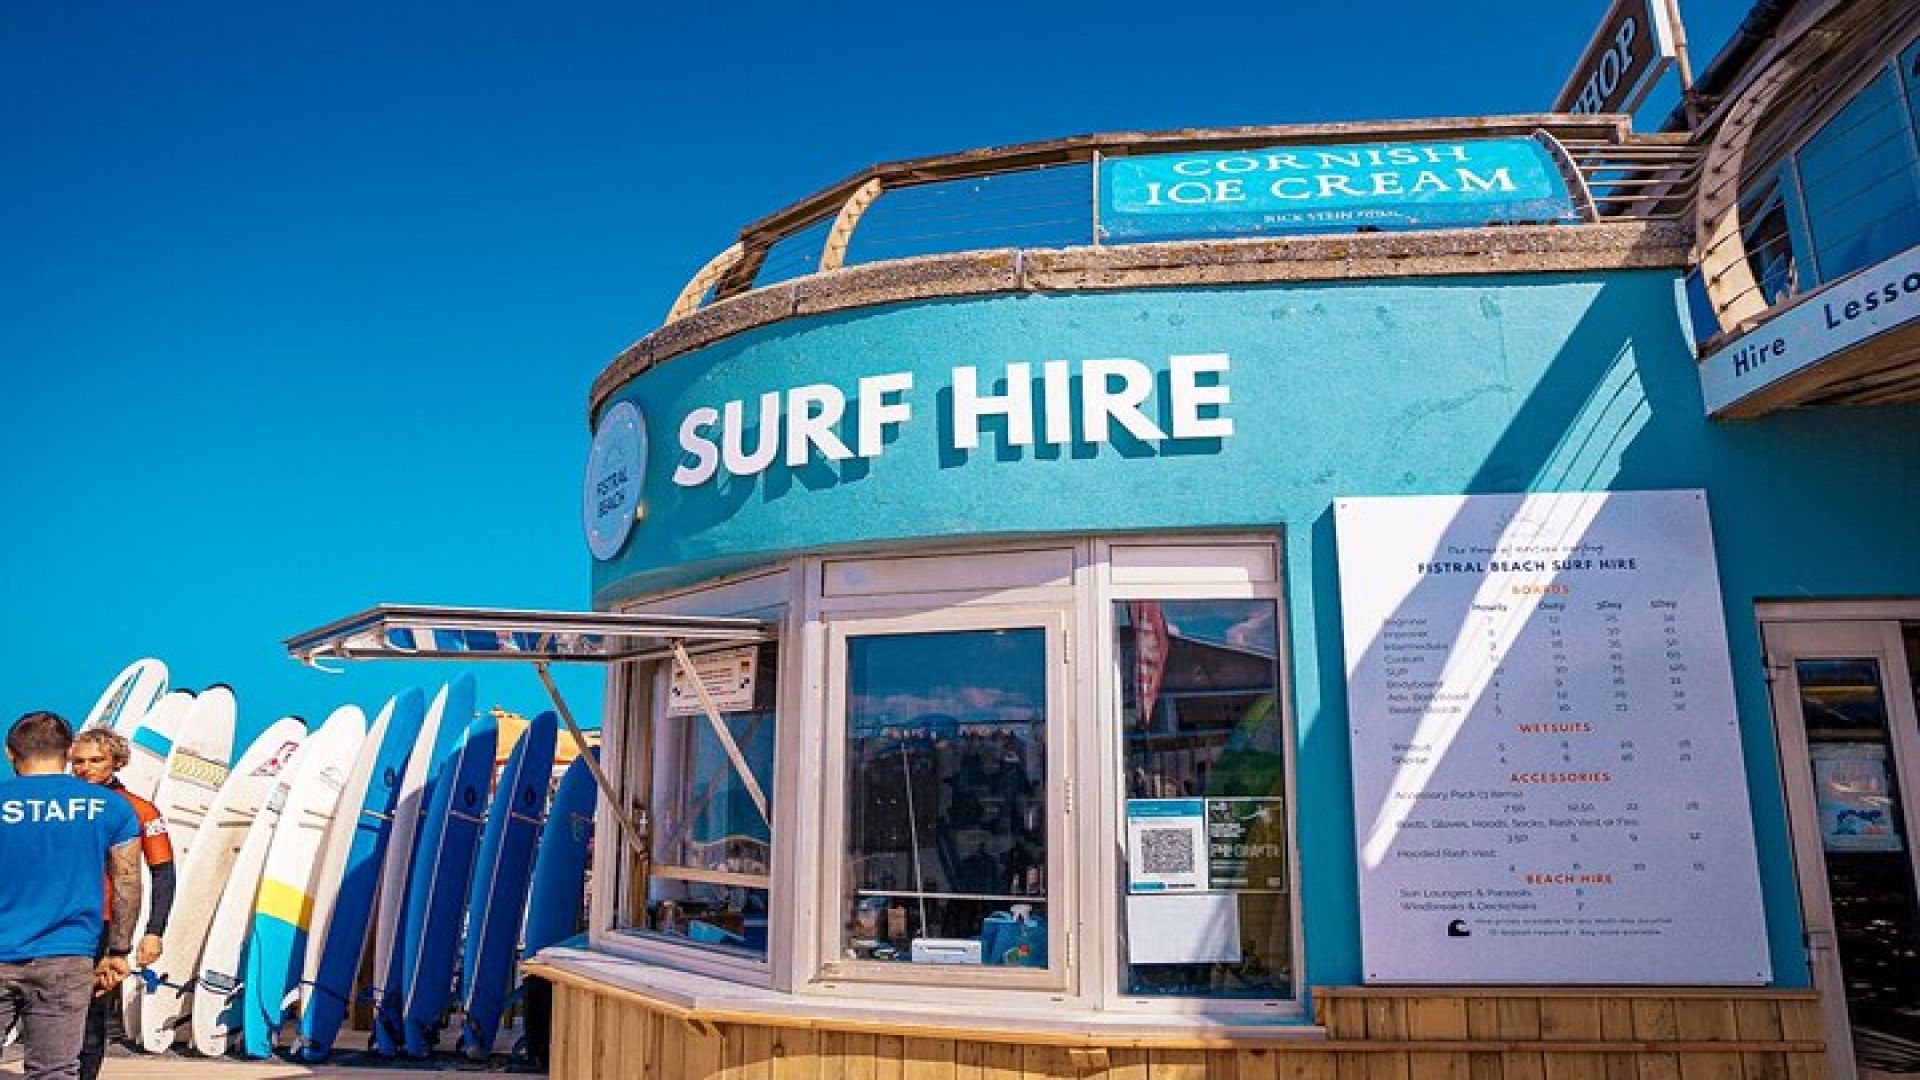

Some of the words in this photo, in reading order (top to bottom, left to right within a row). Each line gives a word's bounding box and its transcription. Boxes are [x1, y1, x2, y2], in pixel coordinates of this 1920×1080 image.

[1172, 145, 1470, 176] CORNISH
[1146, 180, 1246, 205] ICE
[1270, 168, 1518, 199] CREAM
[1732, 338, 1786, 378] Hire
[671, 371, 914, 487] SURF
[951, 352, 1234, 449] HIRE
[1418, 562, 1486, 575] FISTRAL
[1490, 560, 1545, 573] BEACH
[1551, 559, 1594, 572] SURF
[1599, 558, 1638, 571] HIRE
[1511, 584, 1570, 595] BOARDS
[1518, 722, 1592, 733] WETSUITS
[1511, 772, 1612, 784] ACCESSORIES
[2, 798, 107, 824] STAFF
[1526, 873, 1574, 884] BEACH
[1580, 873, 1613, 884] HIRE
